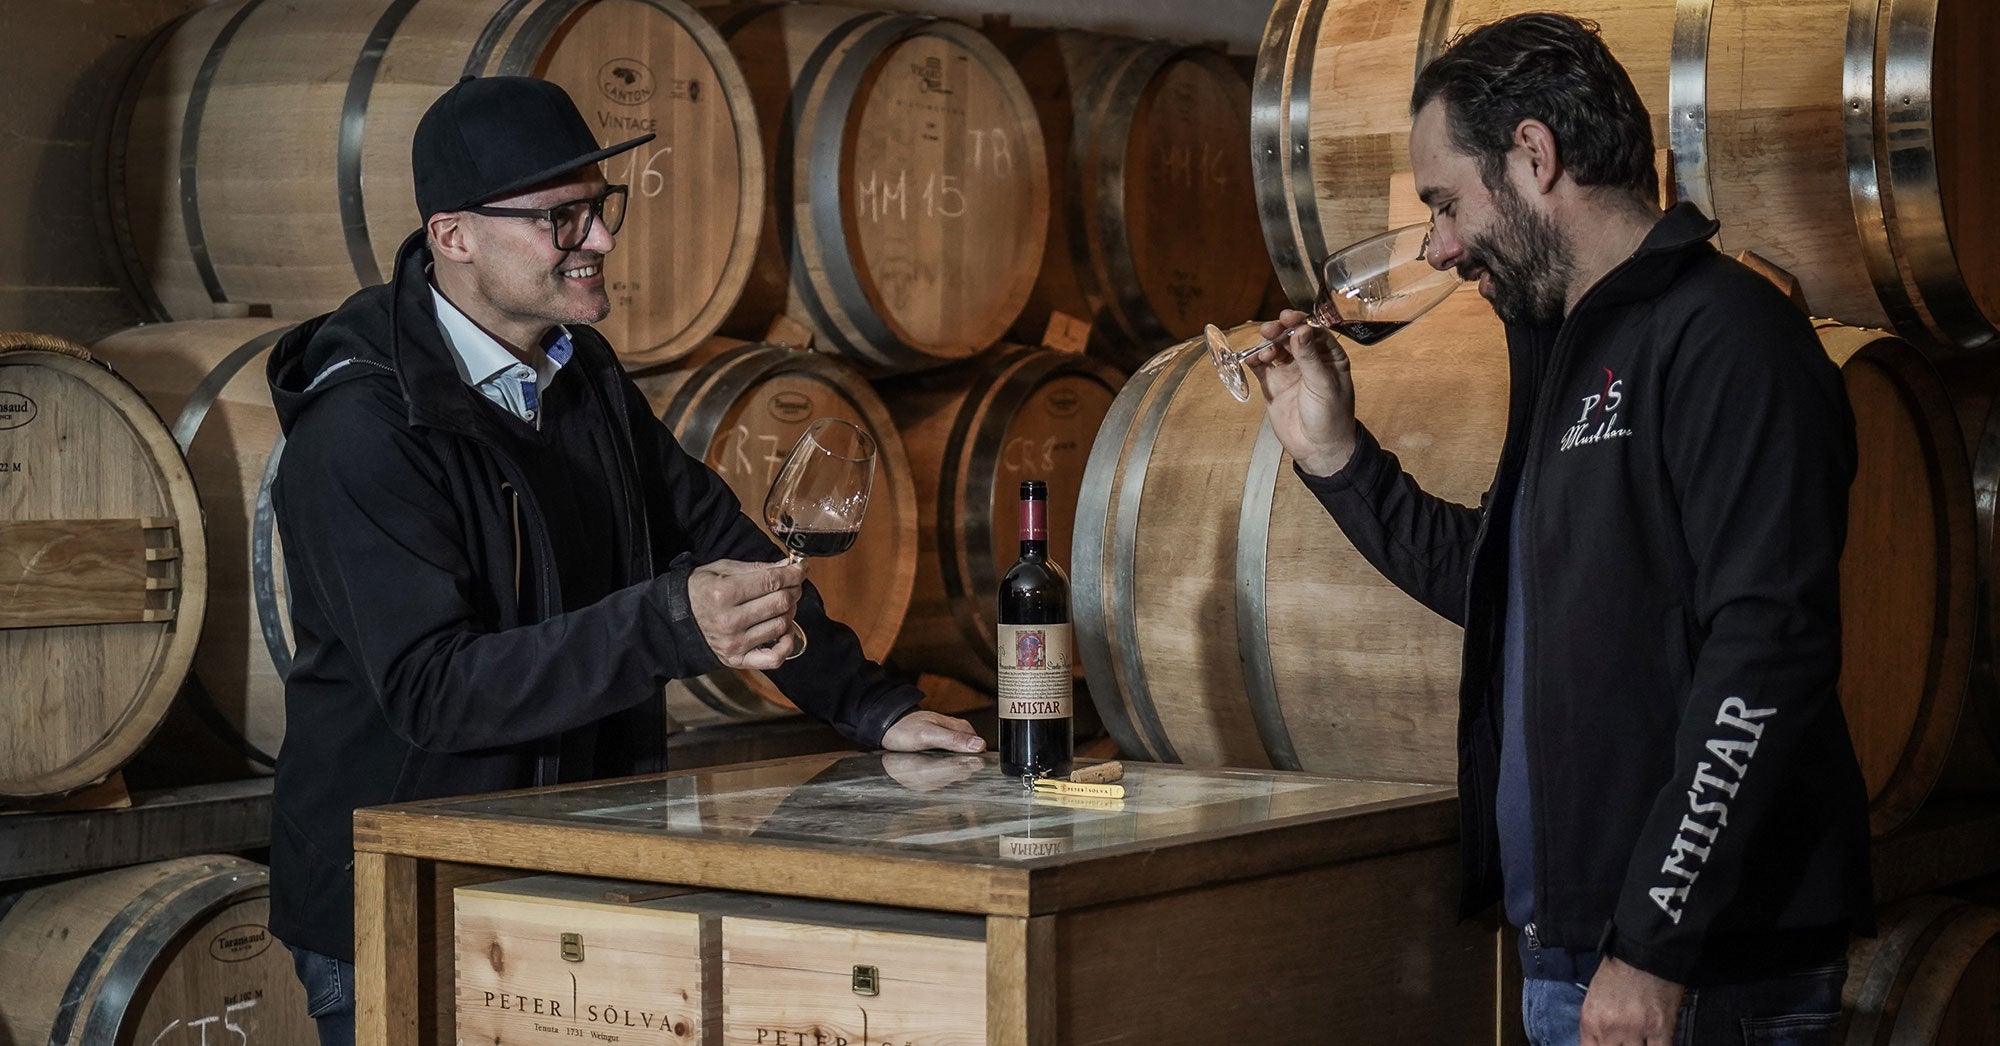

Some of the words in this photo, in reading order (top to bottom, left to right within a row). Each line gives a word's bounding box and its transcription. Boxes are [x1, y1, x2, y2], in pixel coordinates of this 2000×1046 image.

[603, 82, 651, 102] CANTON
[597, 111, 657, 132] VINTAGE
[858, 169, 906, 223] MM
[922, 173, 967, 218] 15
[1560, 422, 1606, 452] Must
[13, 462, 21, 472] M
[1009, 701, 1061, 715] AMISTAR
[1648, 696, 1778, 926] AMISTAR
[219, 930, 265, 949] Taransaud
[484, 991, 562, 1017] PETER
[587, 1004, 673, 1032] SÖLVA
[534, 1023, 559, 1033] Tenuta
[566, 1027, 583, 1037] 1731
[590, 1030, 620, 1042] Weingut
